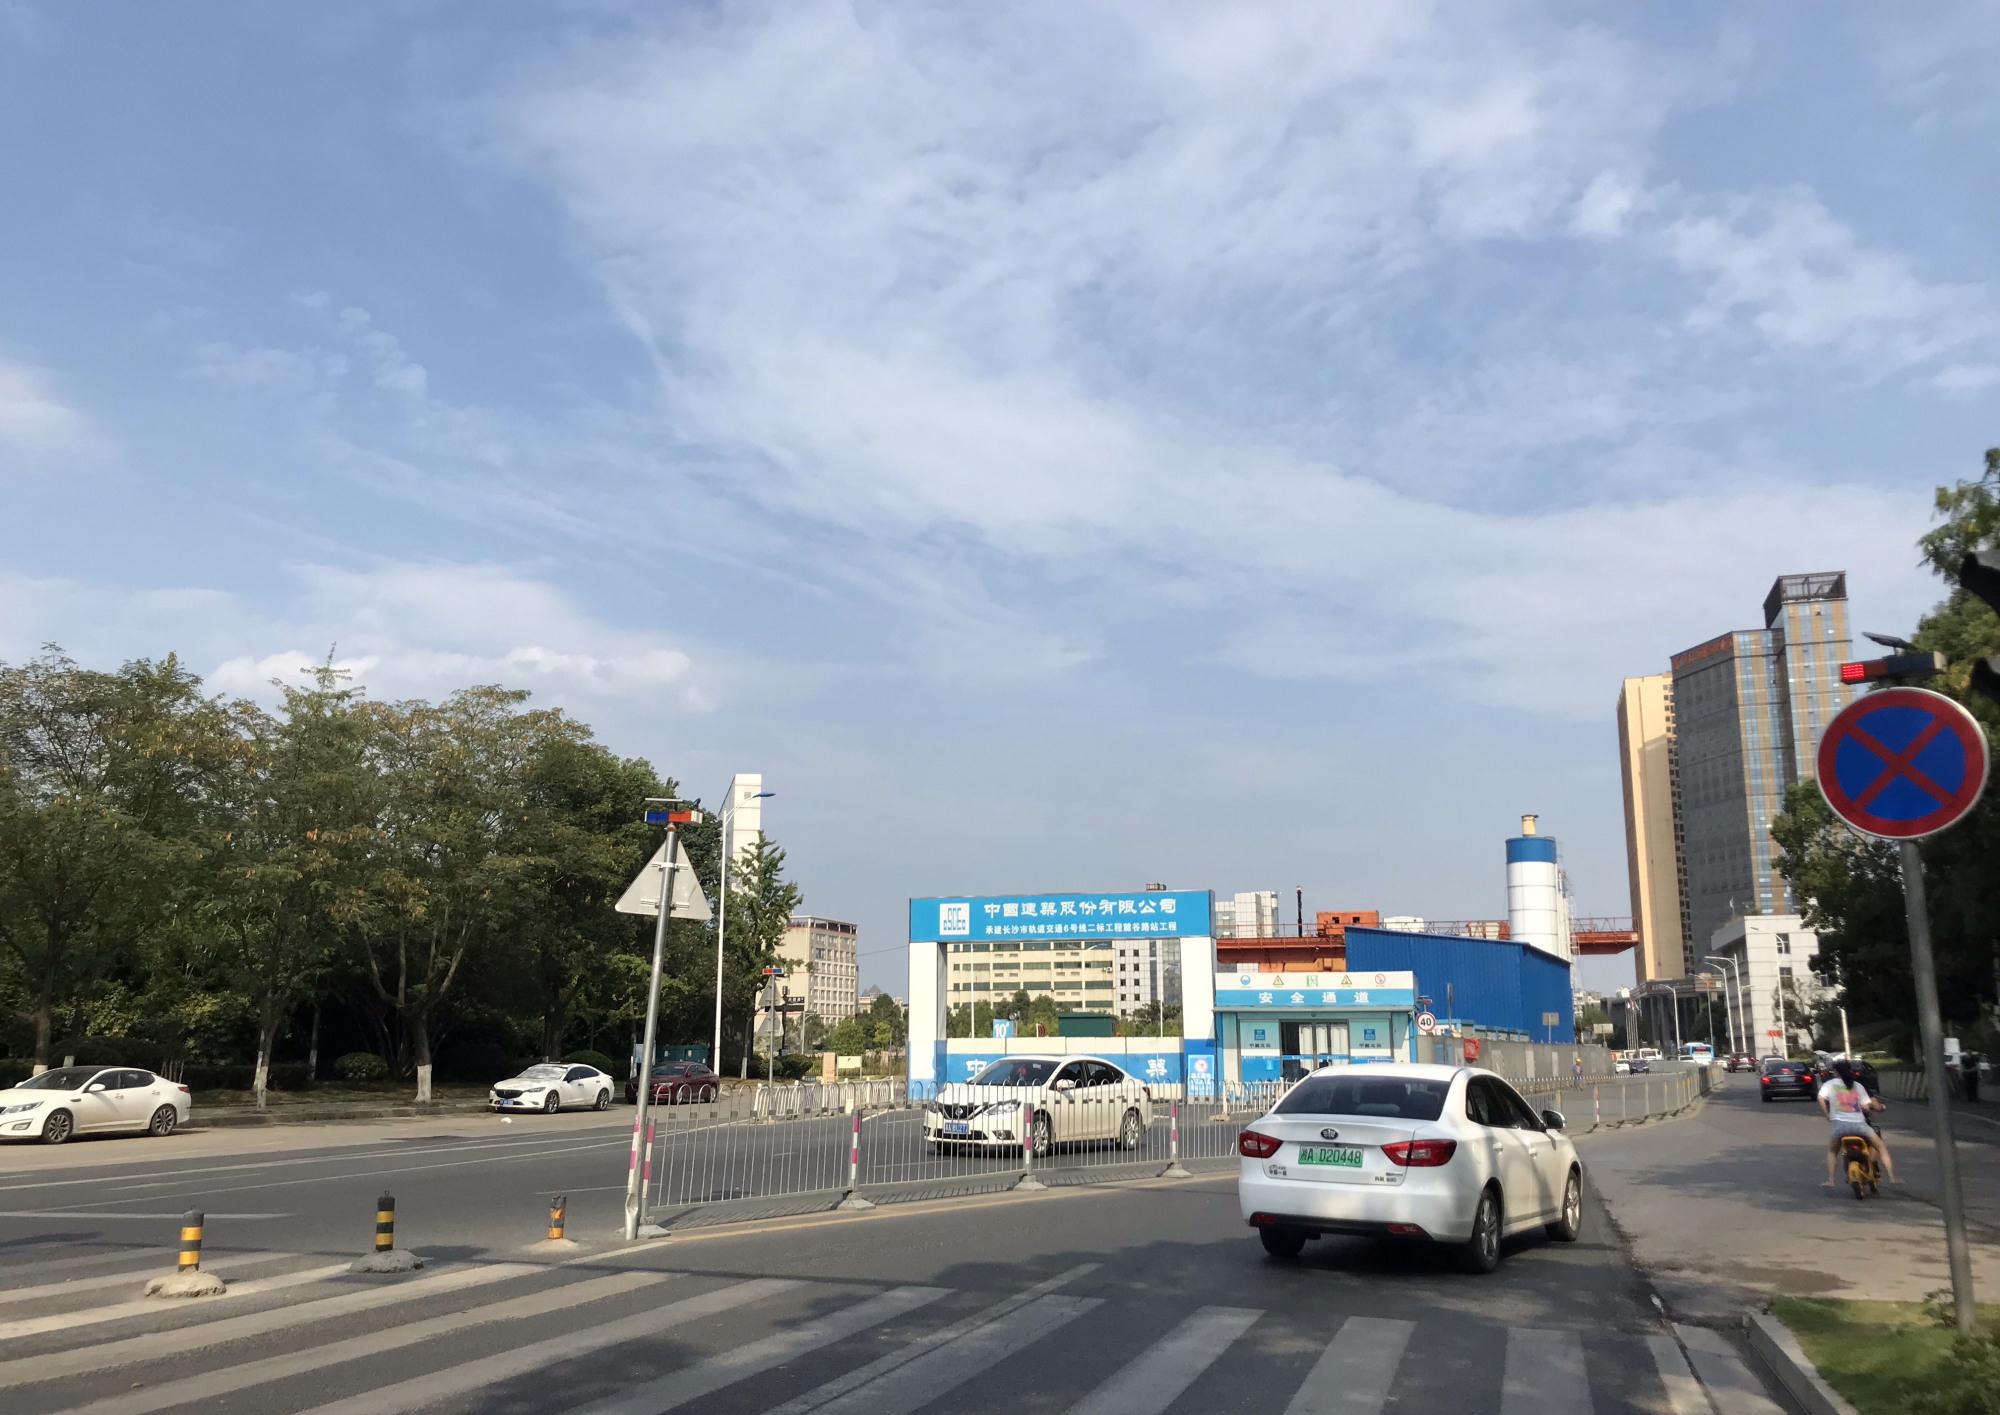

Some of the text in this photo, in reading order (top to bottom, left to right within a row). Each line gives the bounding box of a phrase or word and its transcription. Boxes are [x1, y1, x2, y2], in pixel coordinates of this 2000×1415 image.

[1258, 991, 1370, 1004] 安全通道
[1420, 1017, 1432, 1026] 40
